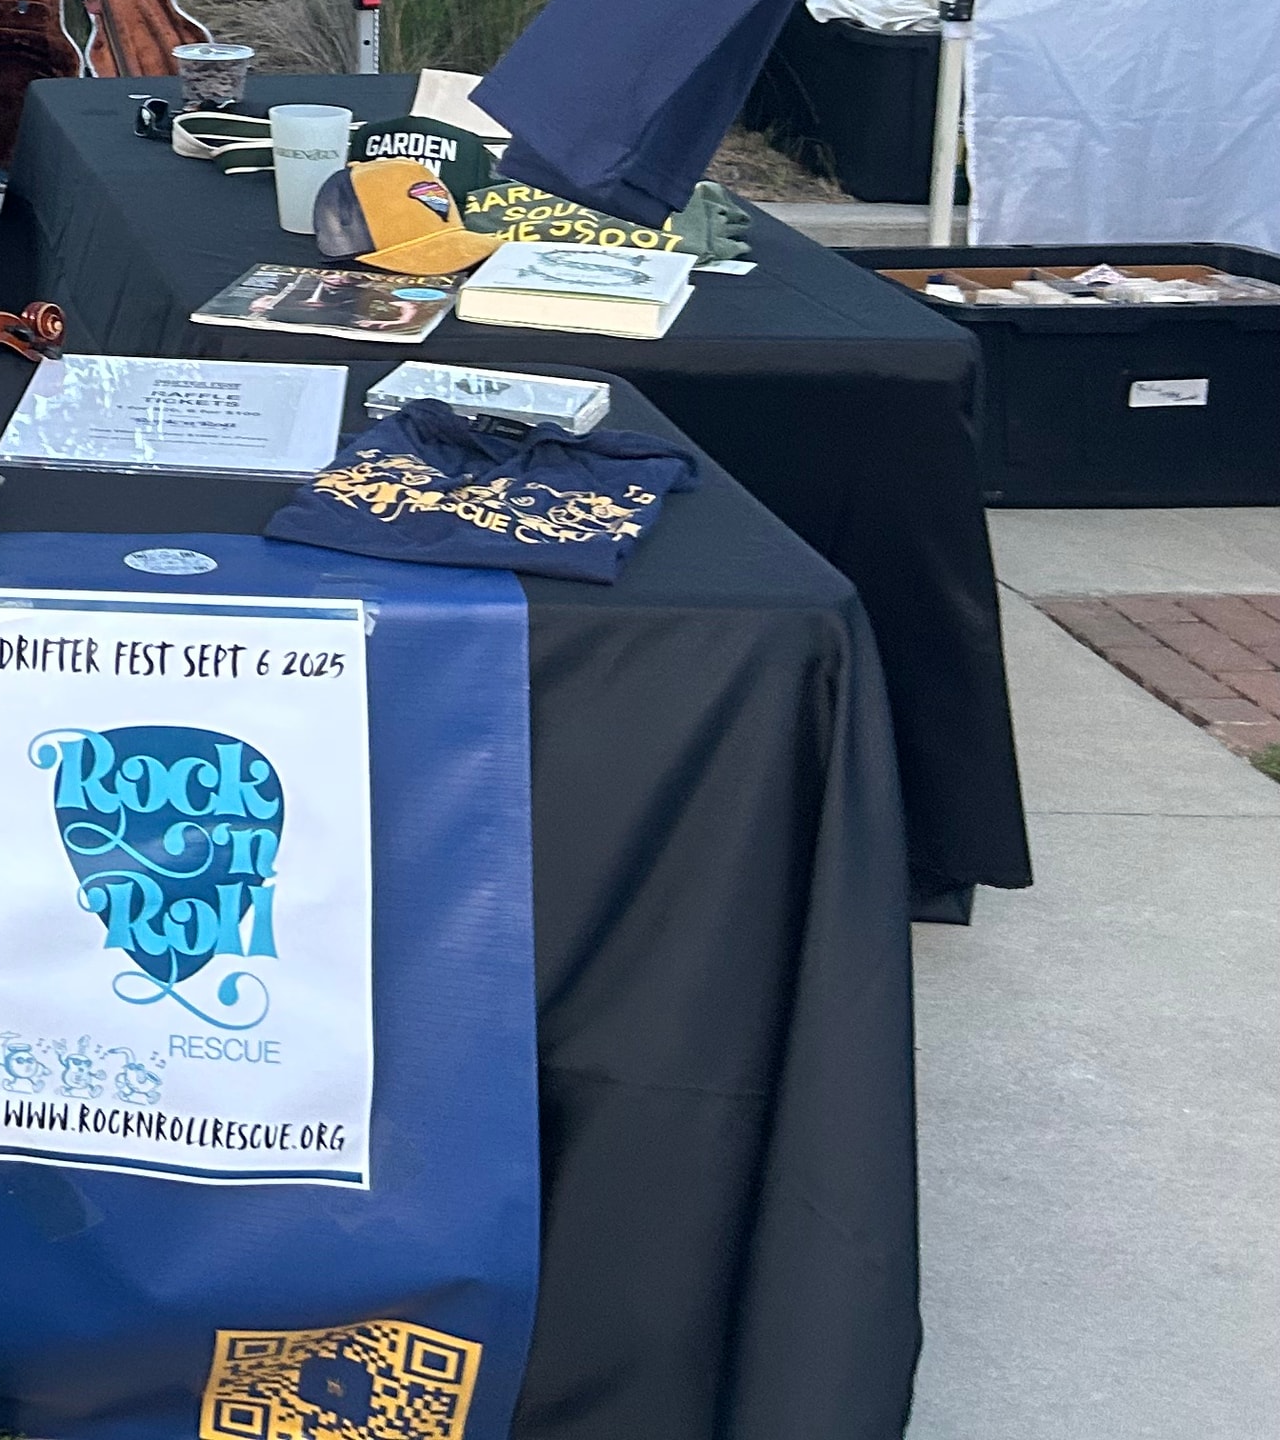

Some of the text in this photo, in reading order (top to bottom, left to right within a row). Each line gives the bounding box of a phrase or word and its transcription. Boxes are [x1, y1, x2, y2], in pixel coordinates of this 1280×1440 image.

[366, 133, 458, 161] GARDEN
[142, 397, 240, 407] TICKETS
[151, 391, 241, 400] RAFFLE
[114, 641, 175, 676] FEST
[183, 644, 247, 679] SEPT
[256, 649, 271, 676] 6
[282, 651, 347, 679] 2025
[28, 728, 280, 838] Rock
[77, 870, 279, 985] Roll
[169, 1033, 281, 1064] RESCUE
[2, 1099, 346, 1153] WWW.ROCKNROLLRESCUE.ORG
